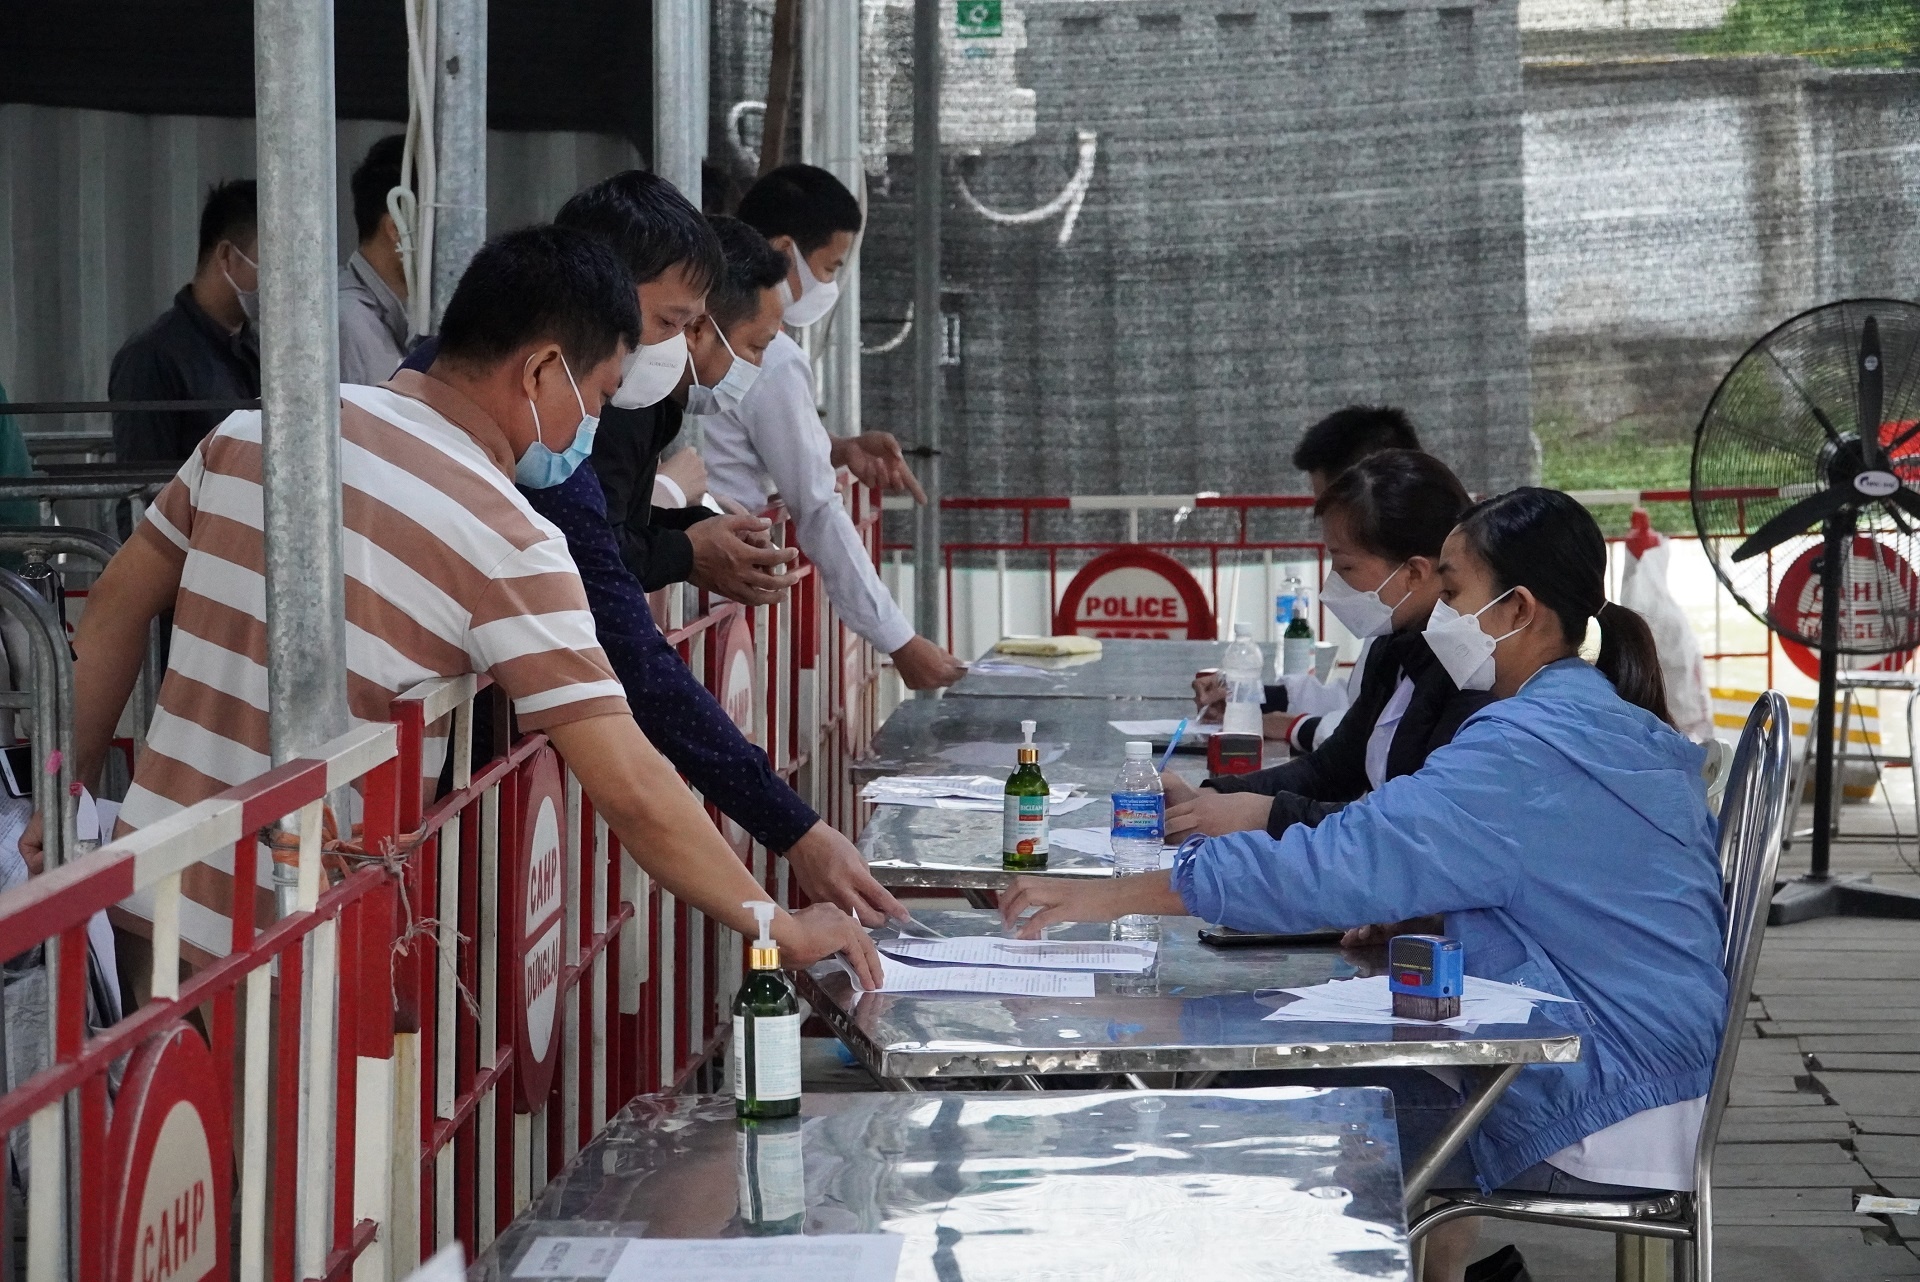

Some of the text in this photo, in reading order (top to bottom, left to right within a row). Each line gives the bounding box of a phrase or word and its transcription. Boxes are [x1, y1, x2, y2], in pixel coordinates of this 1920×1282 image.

[1086, 596, 1177, 618] POLICE
[530, 846, 557, 916] CAHP
[142, 1179, 205, 1282] CAHP
